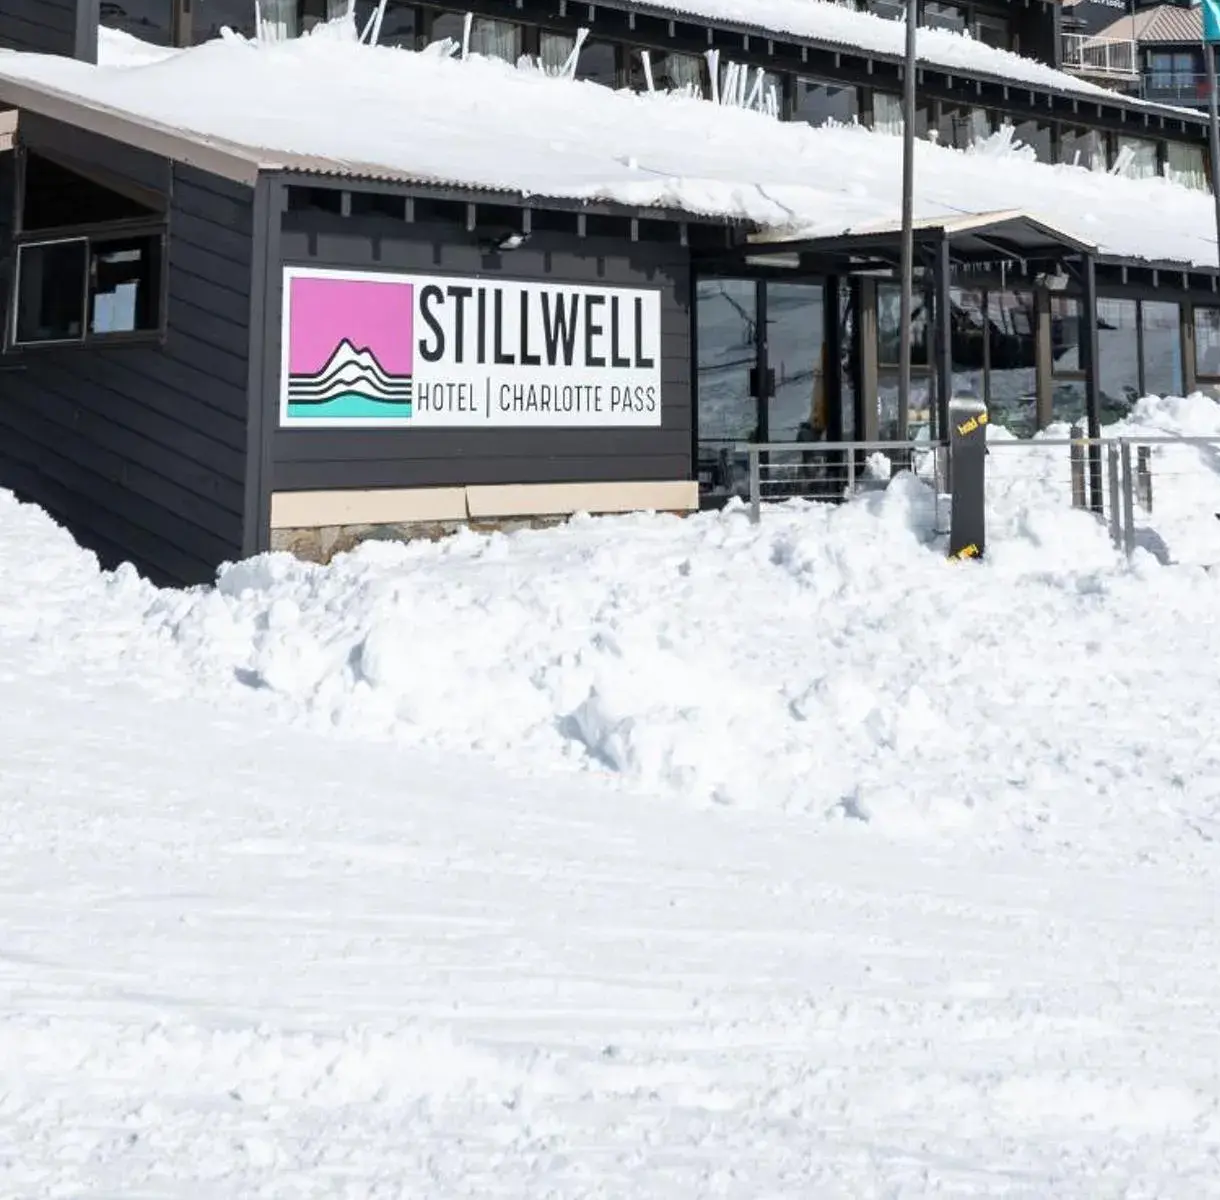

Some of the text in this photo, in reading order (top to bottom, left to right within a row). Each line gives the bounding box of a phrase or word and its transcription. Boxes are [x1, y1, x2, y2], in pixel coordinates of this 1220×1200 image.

[418, 284, 655, 369] STILLWELL
[417, 382, 657, 412] HOTEL CHARLOTTE PASS
